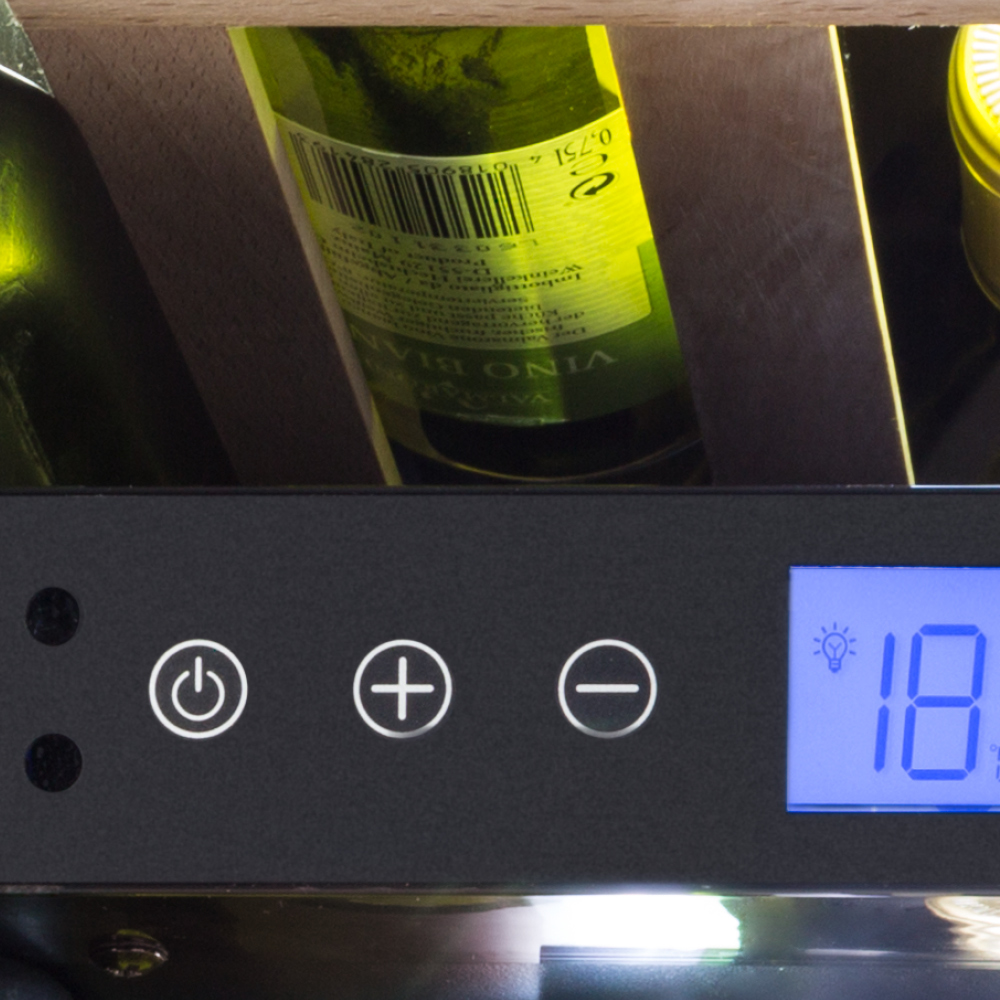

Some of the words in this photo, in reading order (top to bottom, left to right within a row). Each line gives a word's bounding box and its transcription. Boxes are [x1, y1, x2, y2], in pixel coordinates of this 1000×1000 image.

[456, 264, 584, 286] Weinkellerei
[483, 350, 617, 379] VINO
[874, 623, 987, 781] 18
